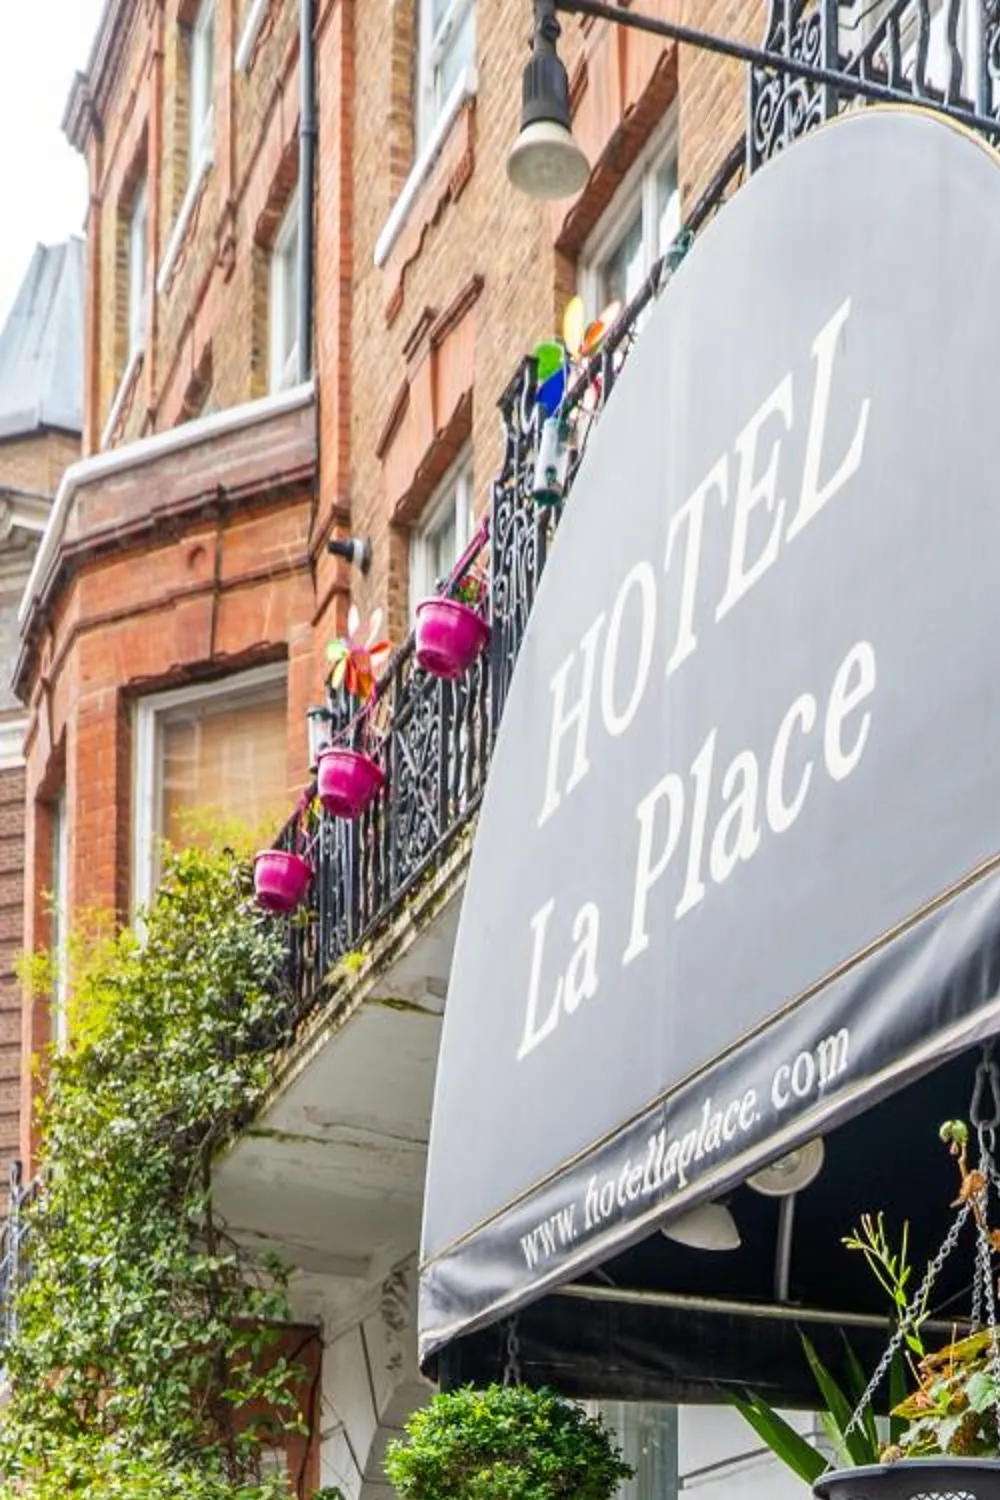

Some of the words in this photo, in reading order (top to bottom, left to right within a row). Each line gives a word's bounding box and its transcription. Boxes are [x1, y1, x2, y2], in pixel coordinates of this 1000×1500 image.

[536, 296, 873, 828] HOTEL
[516, 897, 599, 1061] La
[622, 640, 877, 967] Place
